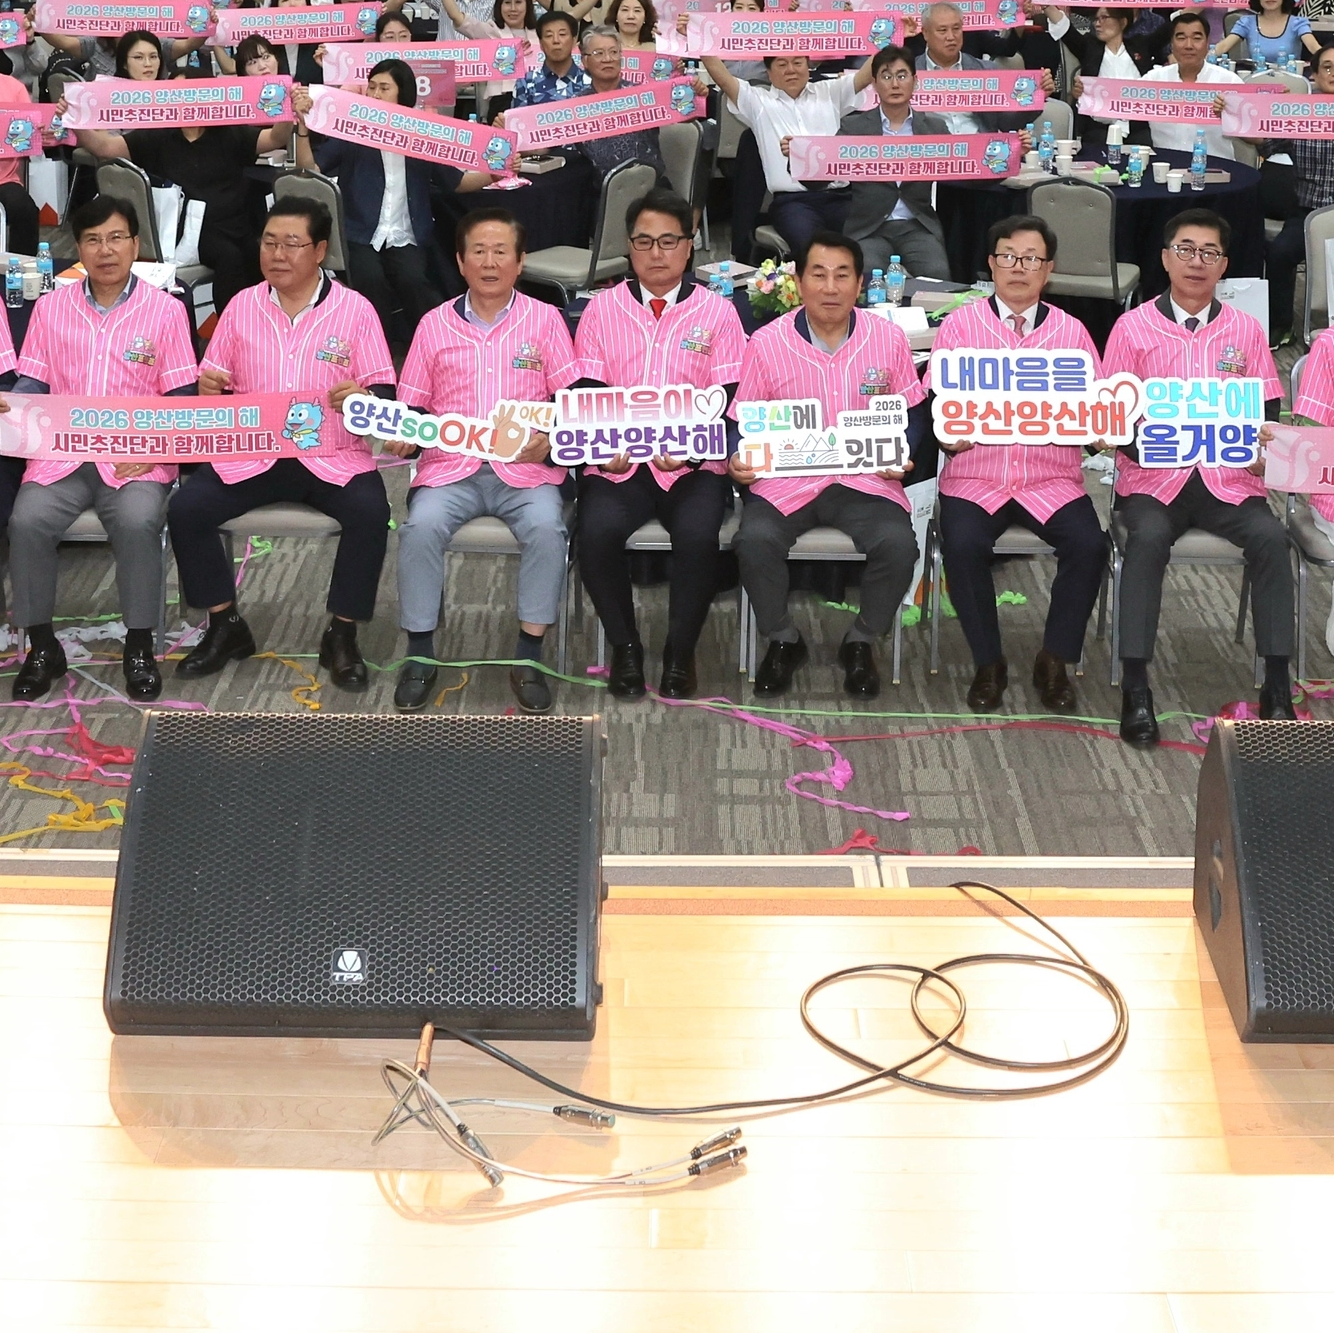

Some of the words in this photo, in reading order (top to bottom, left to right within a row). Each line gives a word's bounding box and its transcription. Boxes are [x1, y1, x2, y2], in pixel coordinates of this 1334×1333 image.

[839, 145, 878, 159] 2026
[882, 144, 949, 158] 양산방문의
[953, 142, 968, 157] 해
[827, 161, 904, 175] 시민추진단과
[908, 158, 981, 174] 함께합니다.
[941, 355, 1088, 392] 내마음을
[562, 388, 693, 425] 내마음이
[875, 400, 902, 412] 2026
[1144, 380, 1261, 420] 양산에
[71, 408, 130, 429] 2026
[135, 408, 235, 429] 양산방문의
[238, 408, 259, 429] 해
[519, 405, 553, 427] OK!
[742, 404, 817, 432] 양산에
[843, 415, 890, 428] 양산방문의
[892, 414, 903, 426] 해
[941, 398, 1126, 437] 양산양산해
[51, 431, 172, 453] 시민추진단과
[177, 431, 280, 452] 함께합니다.
[555, 423, 724, 459] 양산양산해
[844, 435, 904, 470] 잇다
[1141, 423, 1257, 464] 올거양
[332, 972, 364, 981] TPA
